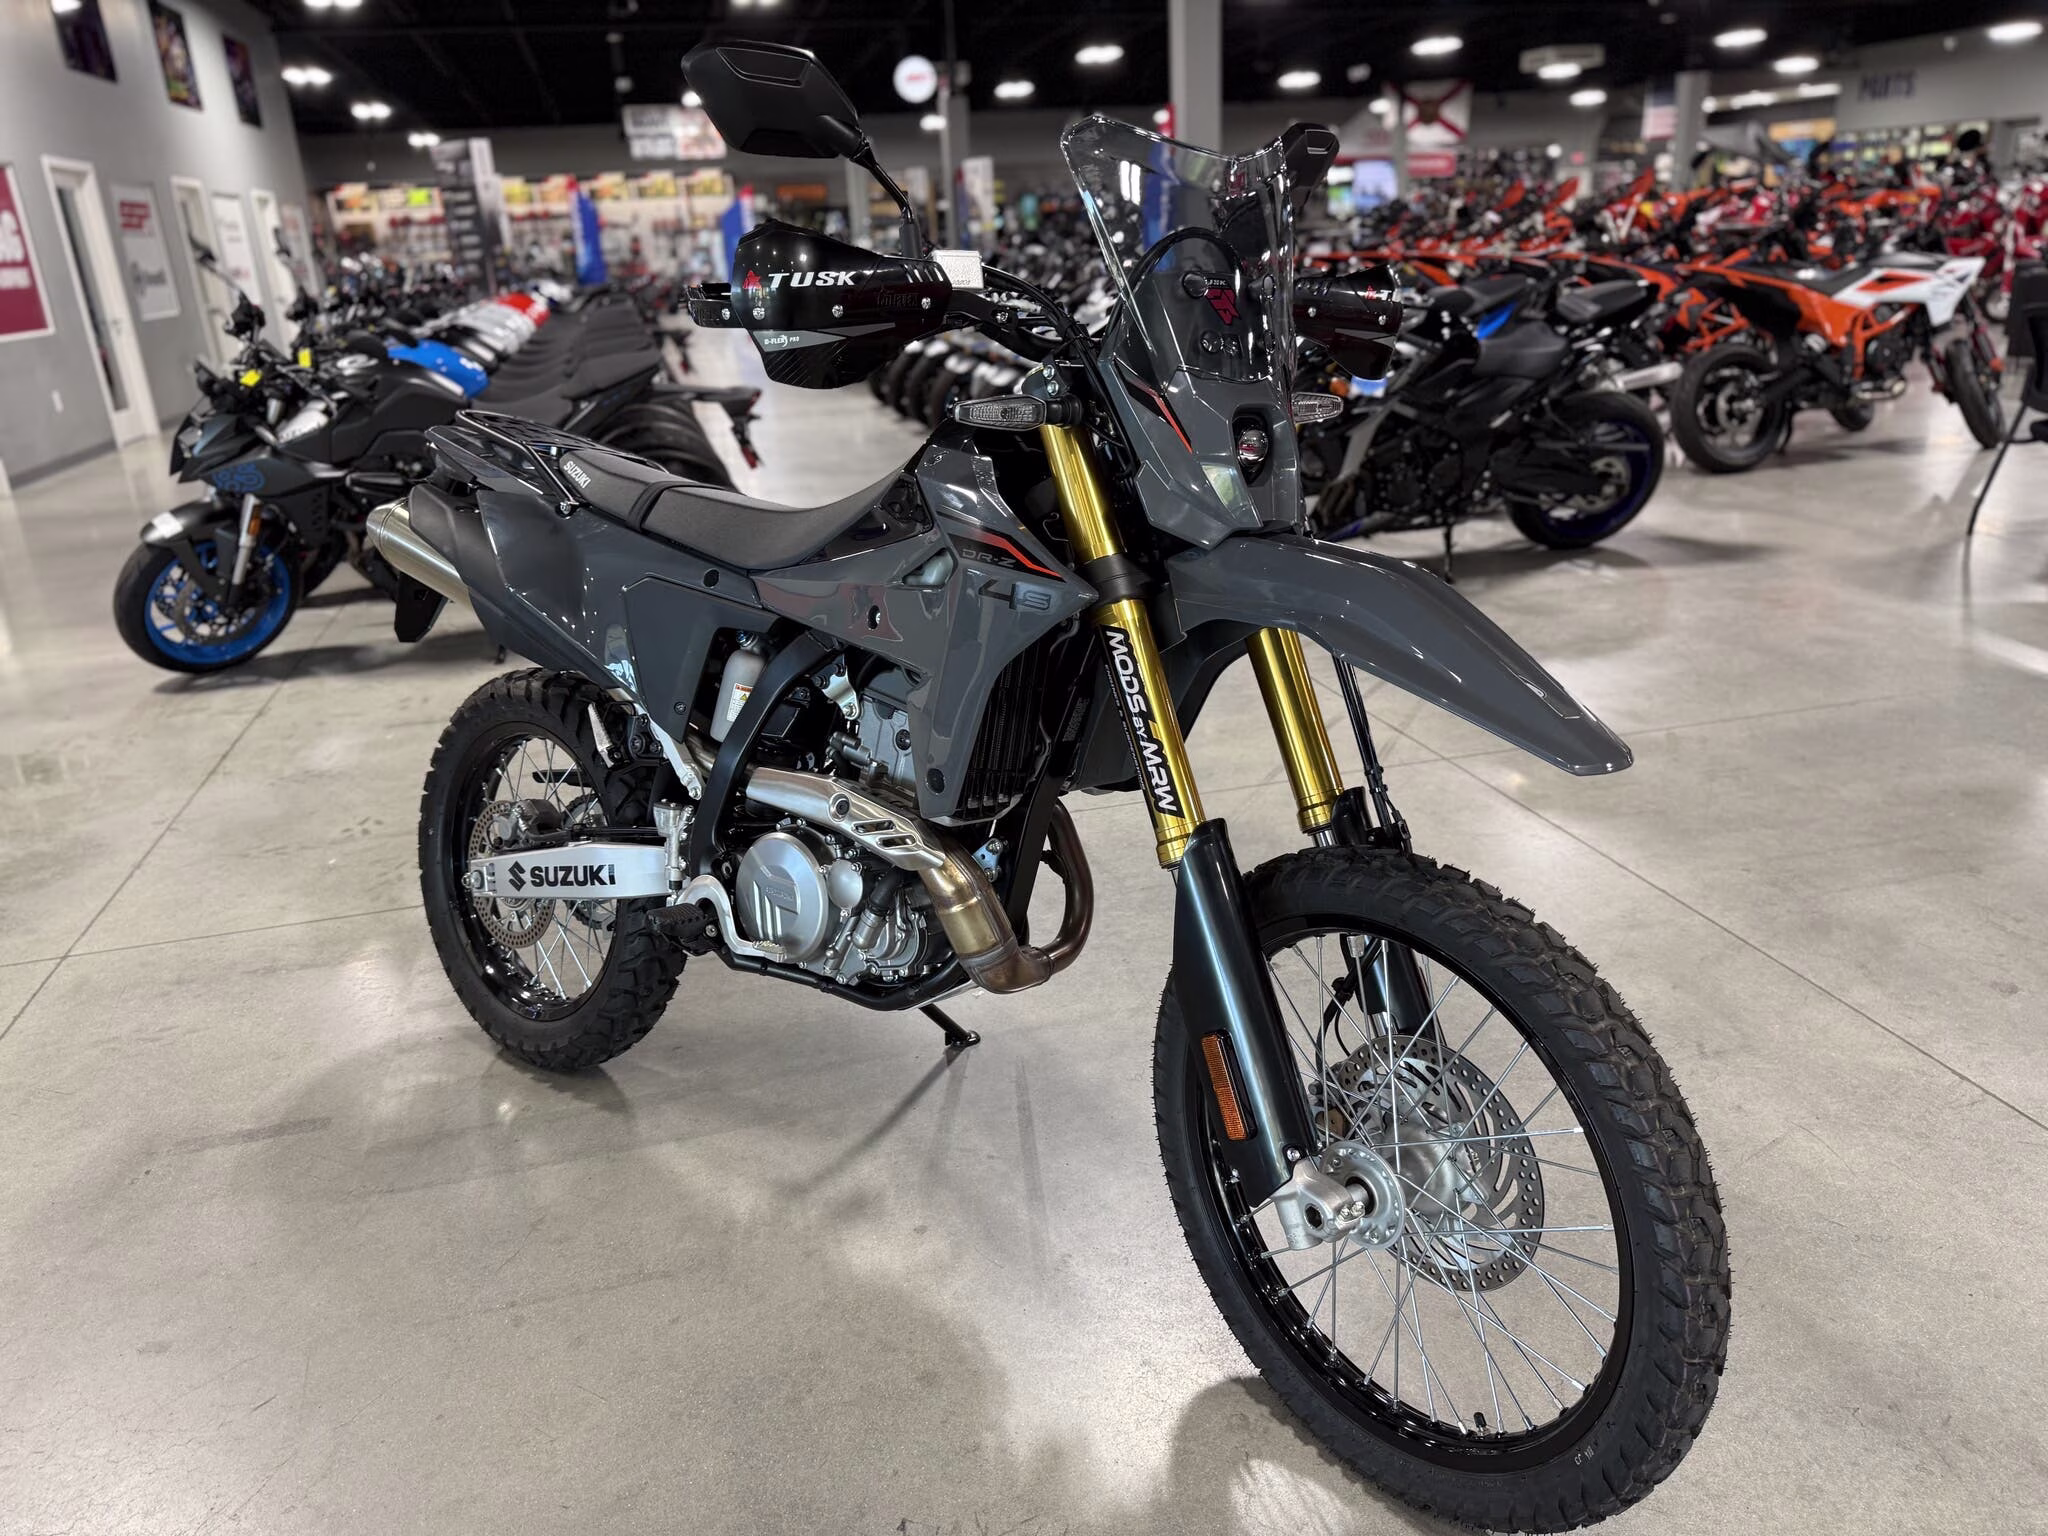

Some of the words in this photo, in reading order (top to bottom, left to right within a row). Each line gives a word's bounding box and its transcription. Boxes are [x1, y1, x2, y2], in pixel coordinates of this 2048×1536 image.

[768, 271, 857, 289] TUSK
[563, 460, 591, 489] SUZUKI
[1105, 630, 1148, 715] MODS
[1131, 716, 1148, 739] BY
[1140, 740, 1178, 812] MRW
[529, 863, 617, 888] SUZUKI
